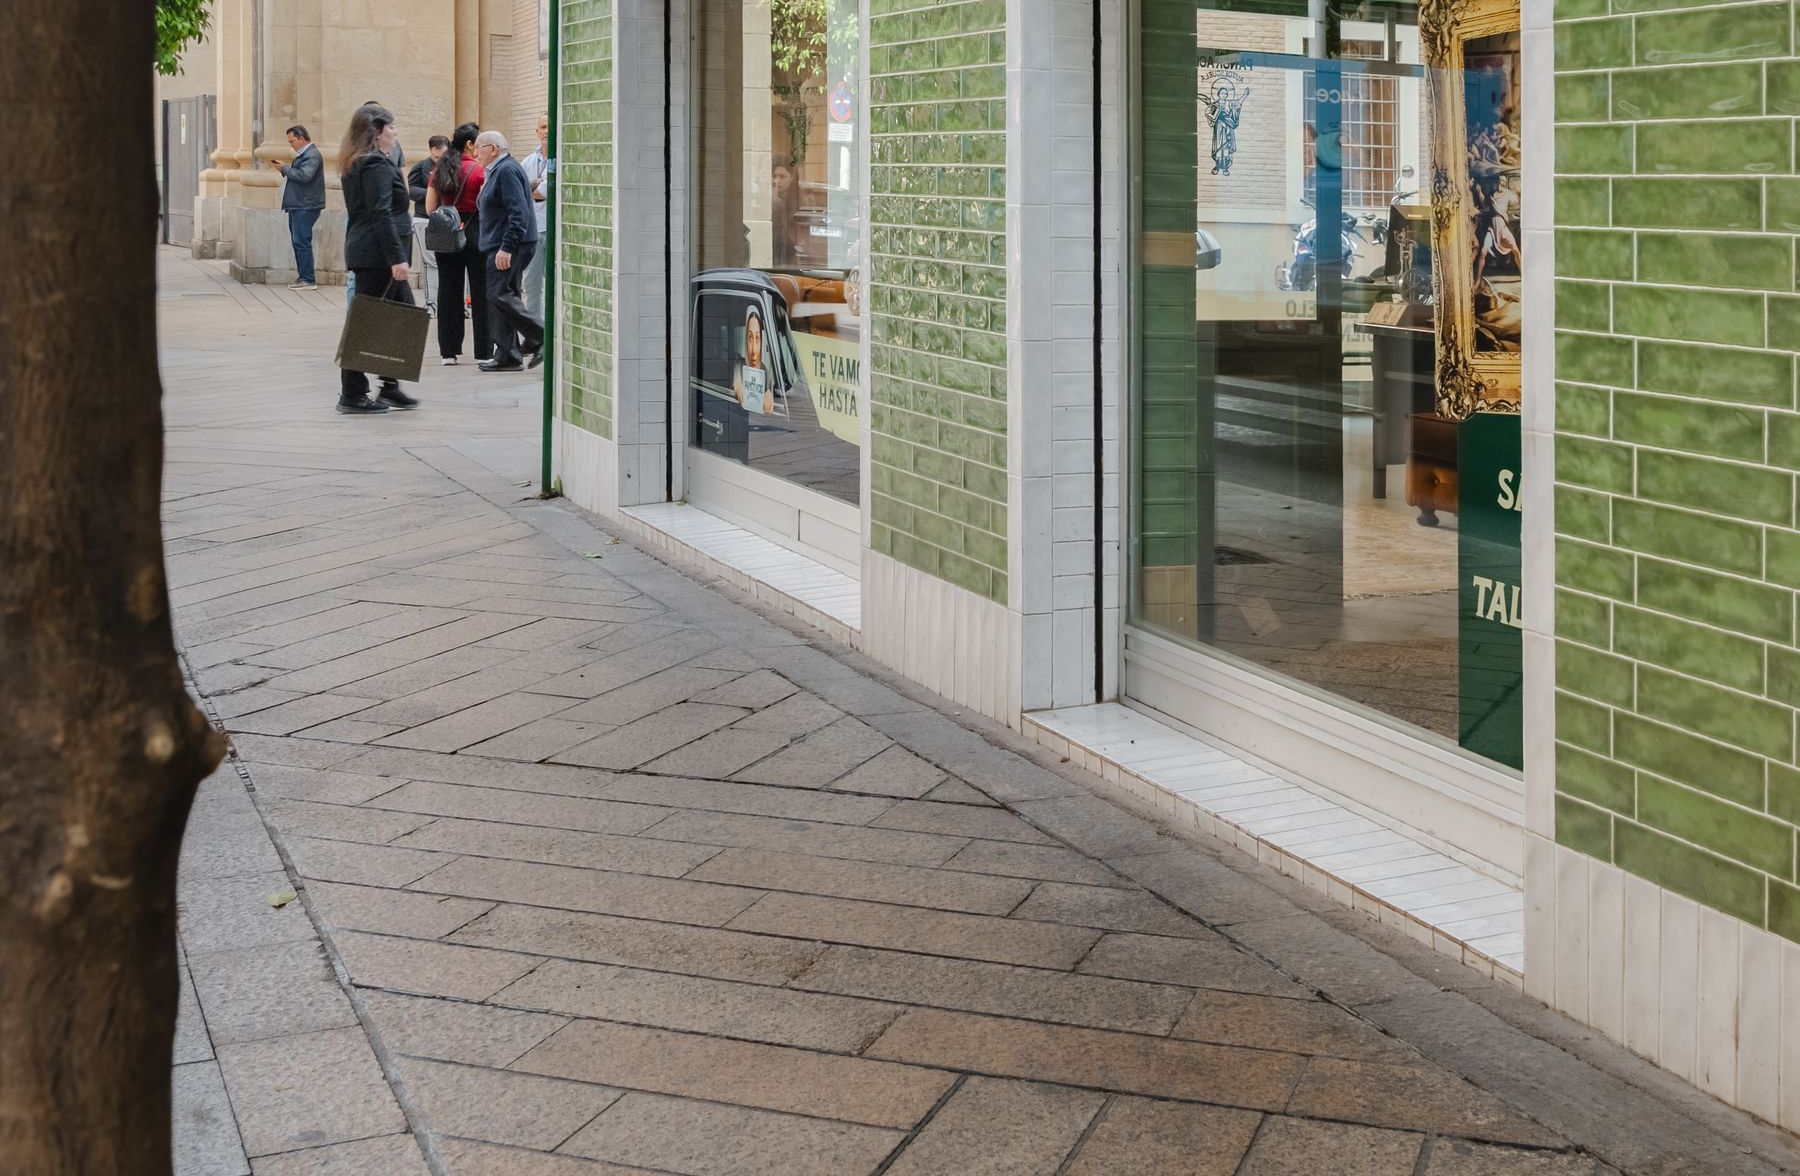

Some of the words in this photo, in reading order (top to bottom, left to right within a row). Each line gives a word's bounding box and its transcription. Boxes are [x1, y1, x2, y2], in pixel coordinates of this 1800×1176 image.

[812, 350, 827, 378] TE
[818, 386, 858, 418] HASTA
[1473, 575, 1521, 629] TAL
